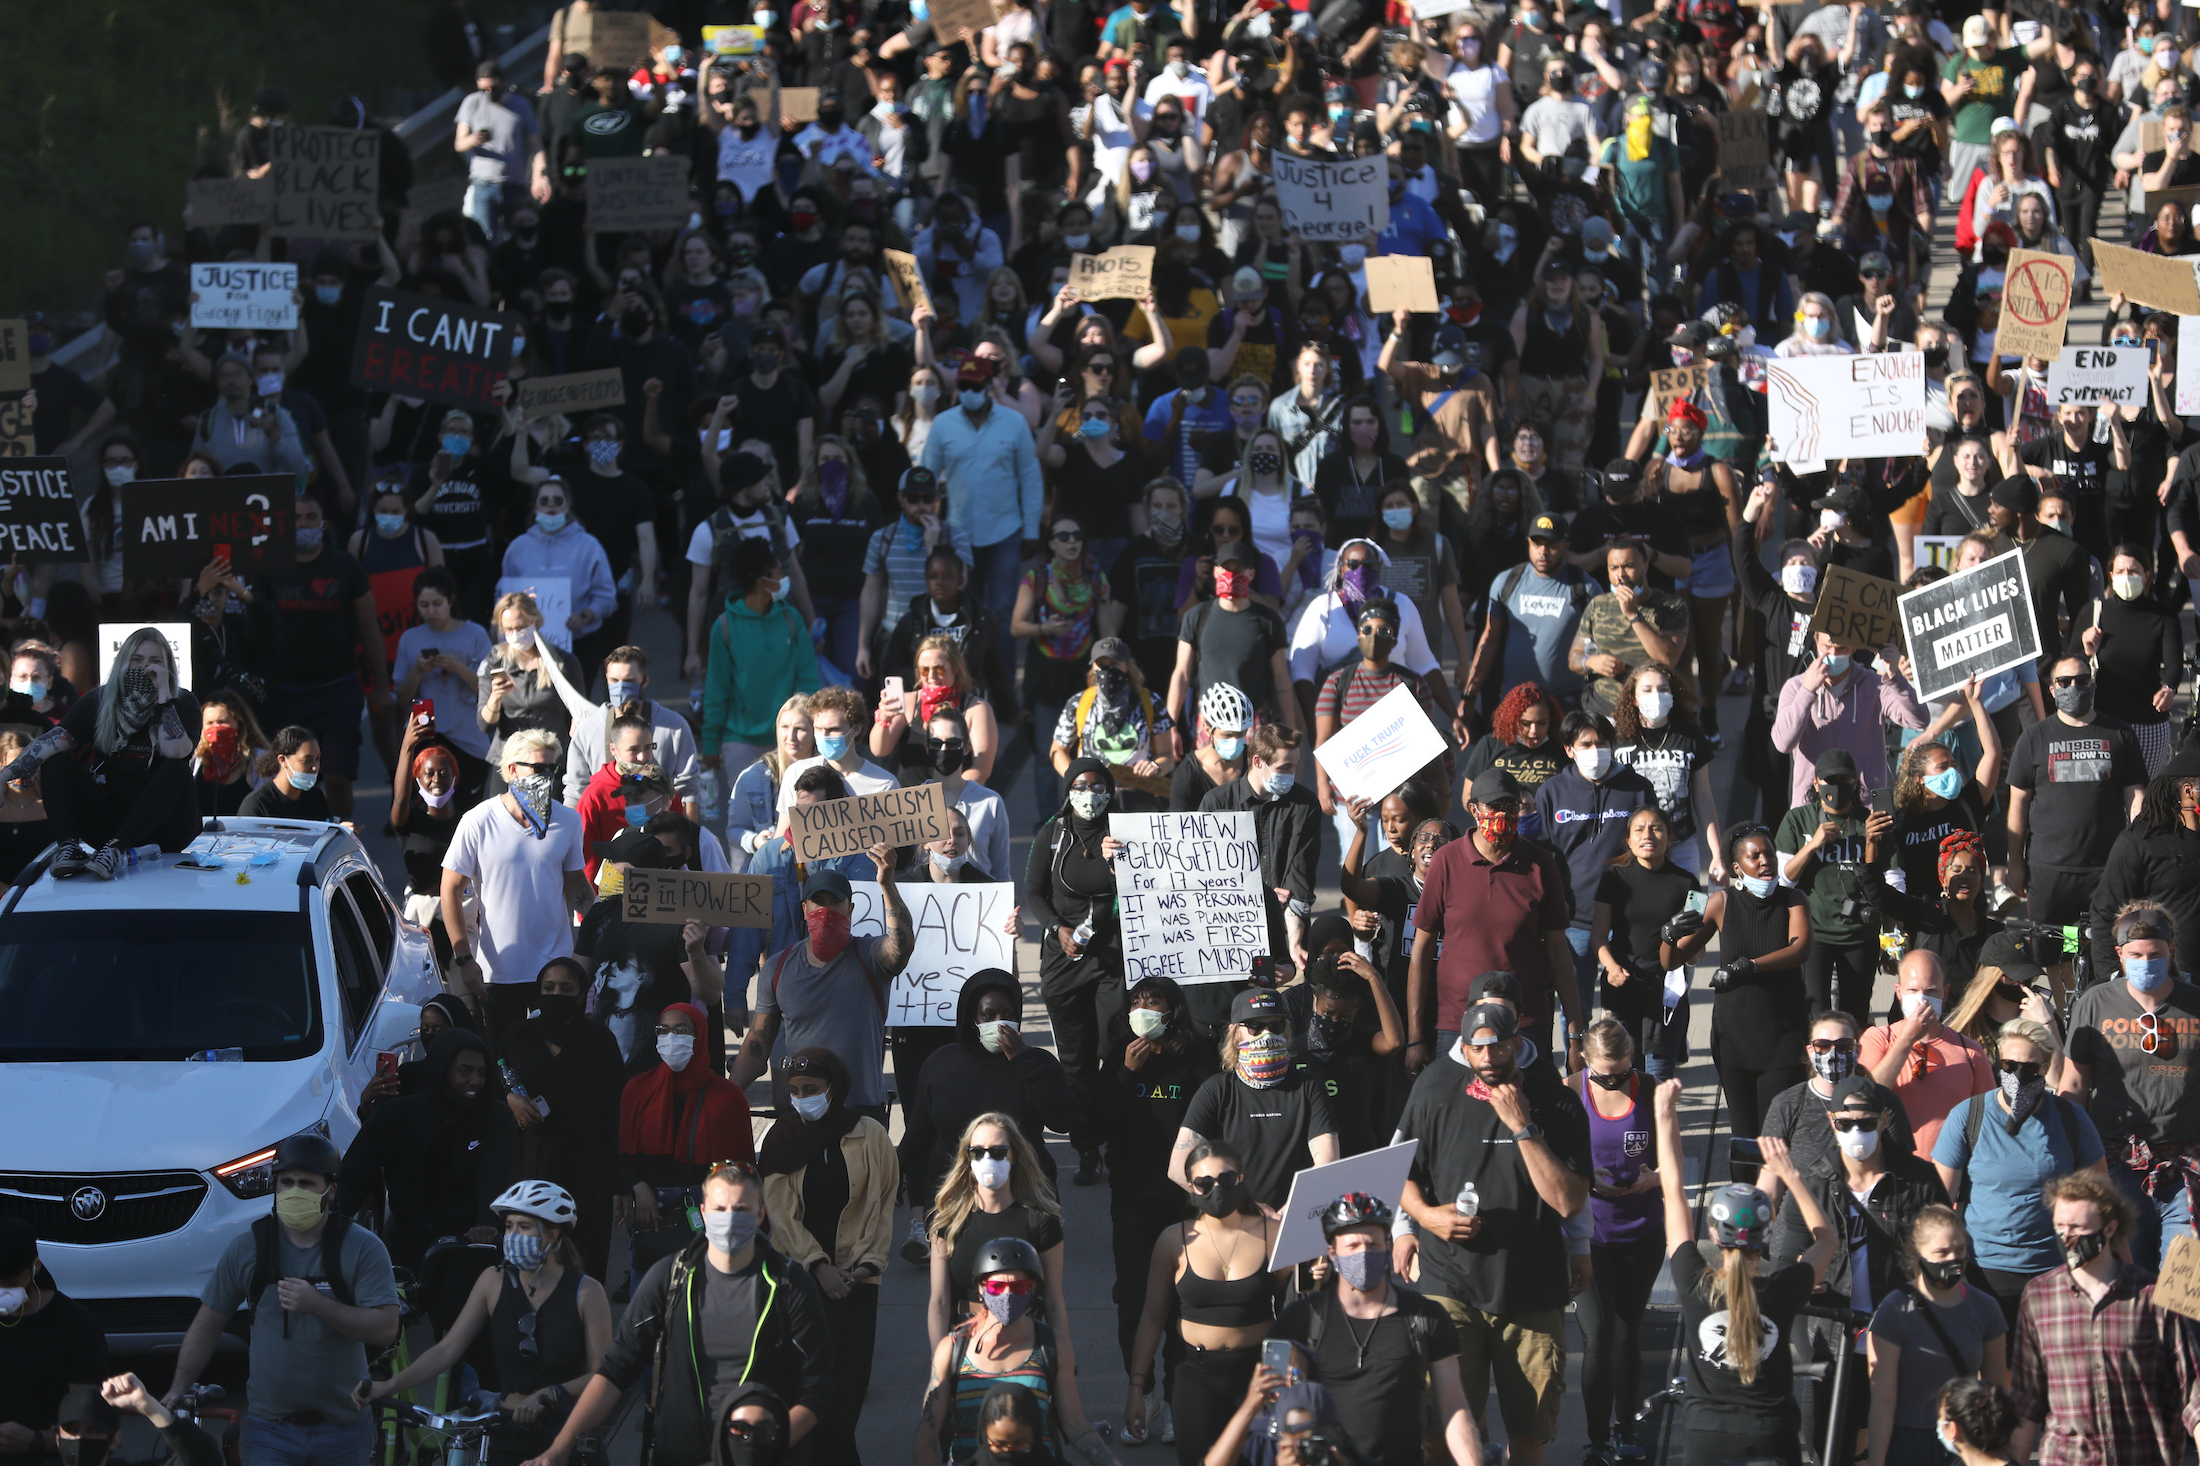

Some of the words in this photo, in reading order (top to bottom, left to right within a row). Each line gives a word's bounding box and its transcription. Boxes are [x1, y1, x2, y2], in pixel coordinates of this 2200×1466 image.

[272, 131, 378, 163] PROTECT
[272, 163, 373, 196] BLACK
[1277, 156, 1379, 188] Justice
[272, 198, 373, 232] LIVES
[1313, 191, 1333, 212] 4
[198, 267, 298, 291] JUSTICE
[2010, 266, 2067, 296] POLICE
[193, 302, 243, 327] George
[247, 303, 290, 327] Floyd
[375, 300, 396, 334] I
[407, 307, 504, 358] CANT
[1851, 357, 1922, 382] ENOUGH
[2075, 350, 2118, 368] END
[1657, 368, 1708, 391] BOB
[1860, 385, 1901, 408] IS
[2058, 386, 2136, 404] SUPREMACY
[1849, 409, 1924, 439] ENOUGH
[0, 469, 73, 499] USTICE
[141, 514, 178, 543] AM
[183, 512, 199, 540] I
[1831, 575, 1854, 604] I
[1911, 598, 1968, 637] BLACK
[1972, 577, 2019, 616] LIVES
[1827, 604, 1903, 651] BREA
[1940, 624, 2006, 664] MATTER
[1343, 742, 1374, 770] FUCK
[1371, 716, 1406, 751] TRUMP
[2050, 741, 2066, 755] IN
[2067, 739, 2101, 751] 1985
[2056, 752, 2071, 761] US
[2072, 751, 2098, 761] HOW
[2099, 750, 2111, 760] TO
[1494, 758, 1558, 770] BLACK
[2056, 760, 2105, 782] FLY
[796, 800, 857, 833] YOUR
[861, 788, 935, 823] RACISM
[802, 825, 886, 860] CAUSED
[891, 816, 941, 843] THIS
[1149, 815, 1173, 841] HE
[1180, 814, 1237, 841] KNEW
[1905, 827, 1937, 846] OVER
[1115, 841, 1261, 873] #GEORGEFLOYD
[627, 868, 651, 919] REST
[683, 878, 770, 918] POWER.
[1170, 872, 1187, 890] 17
[1198, 873, 1245, 897] years!
[1122, 894, 1147, 914] IT
[1157, 894, 1188, 910] WAS
[1193, 893, 1264, 909] PERSONAL!
[850, 890, 1004, 960] BACK
[1124, 915, 1147, 934] IT
[1160, 913, 1191, 927] WAS
[1195, 910, 1260, 925] PLANNED!
[1126, 935, 1151, 953] IT
[1163, 929, 1196, 945] WAS
[1206, 925, 1266, 945] FIRST
[896, 966, 964, 993] ives
[1127, 952, 1188, 982] DEGREE
[898, 990, 958, 1023] tte
[1627, 1133, 1646, 1141] GAF
[2177, 1242, 2190, 1258] A
[2161, 1275, 2175, 1292] A
